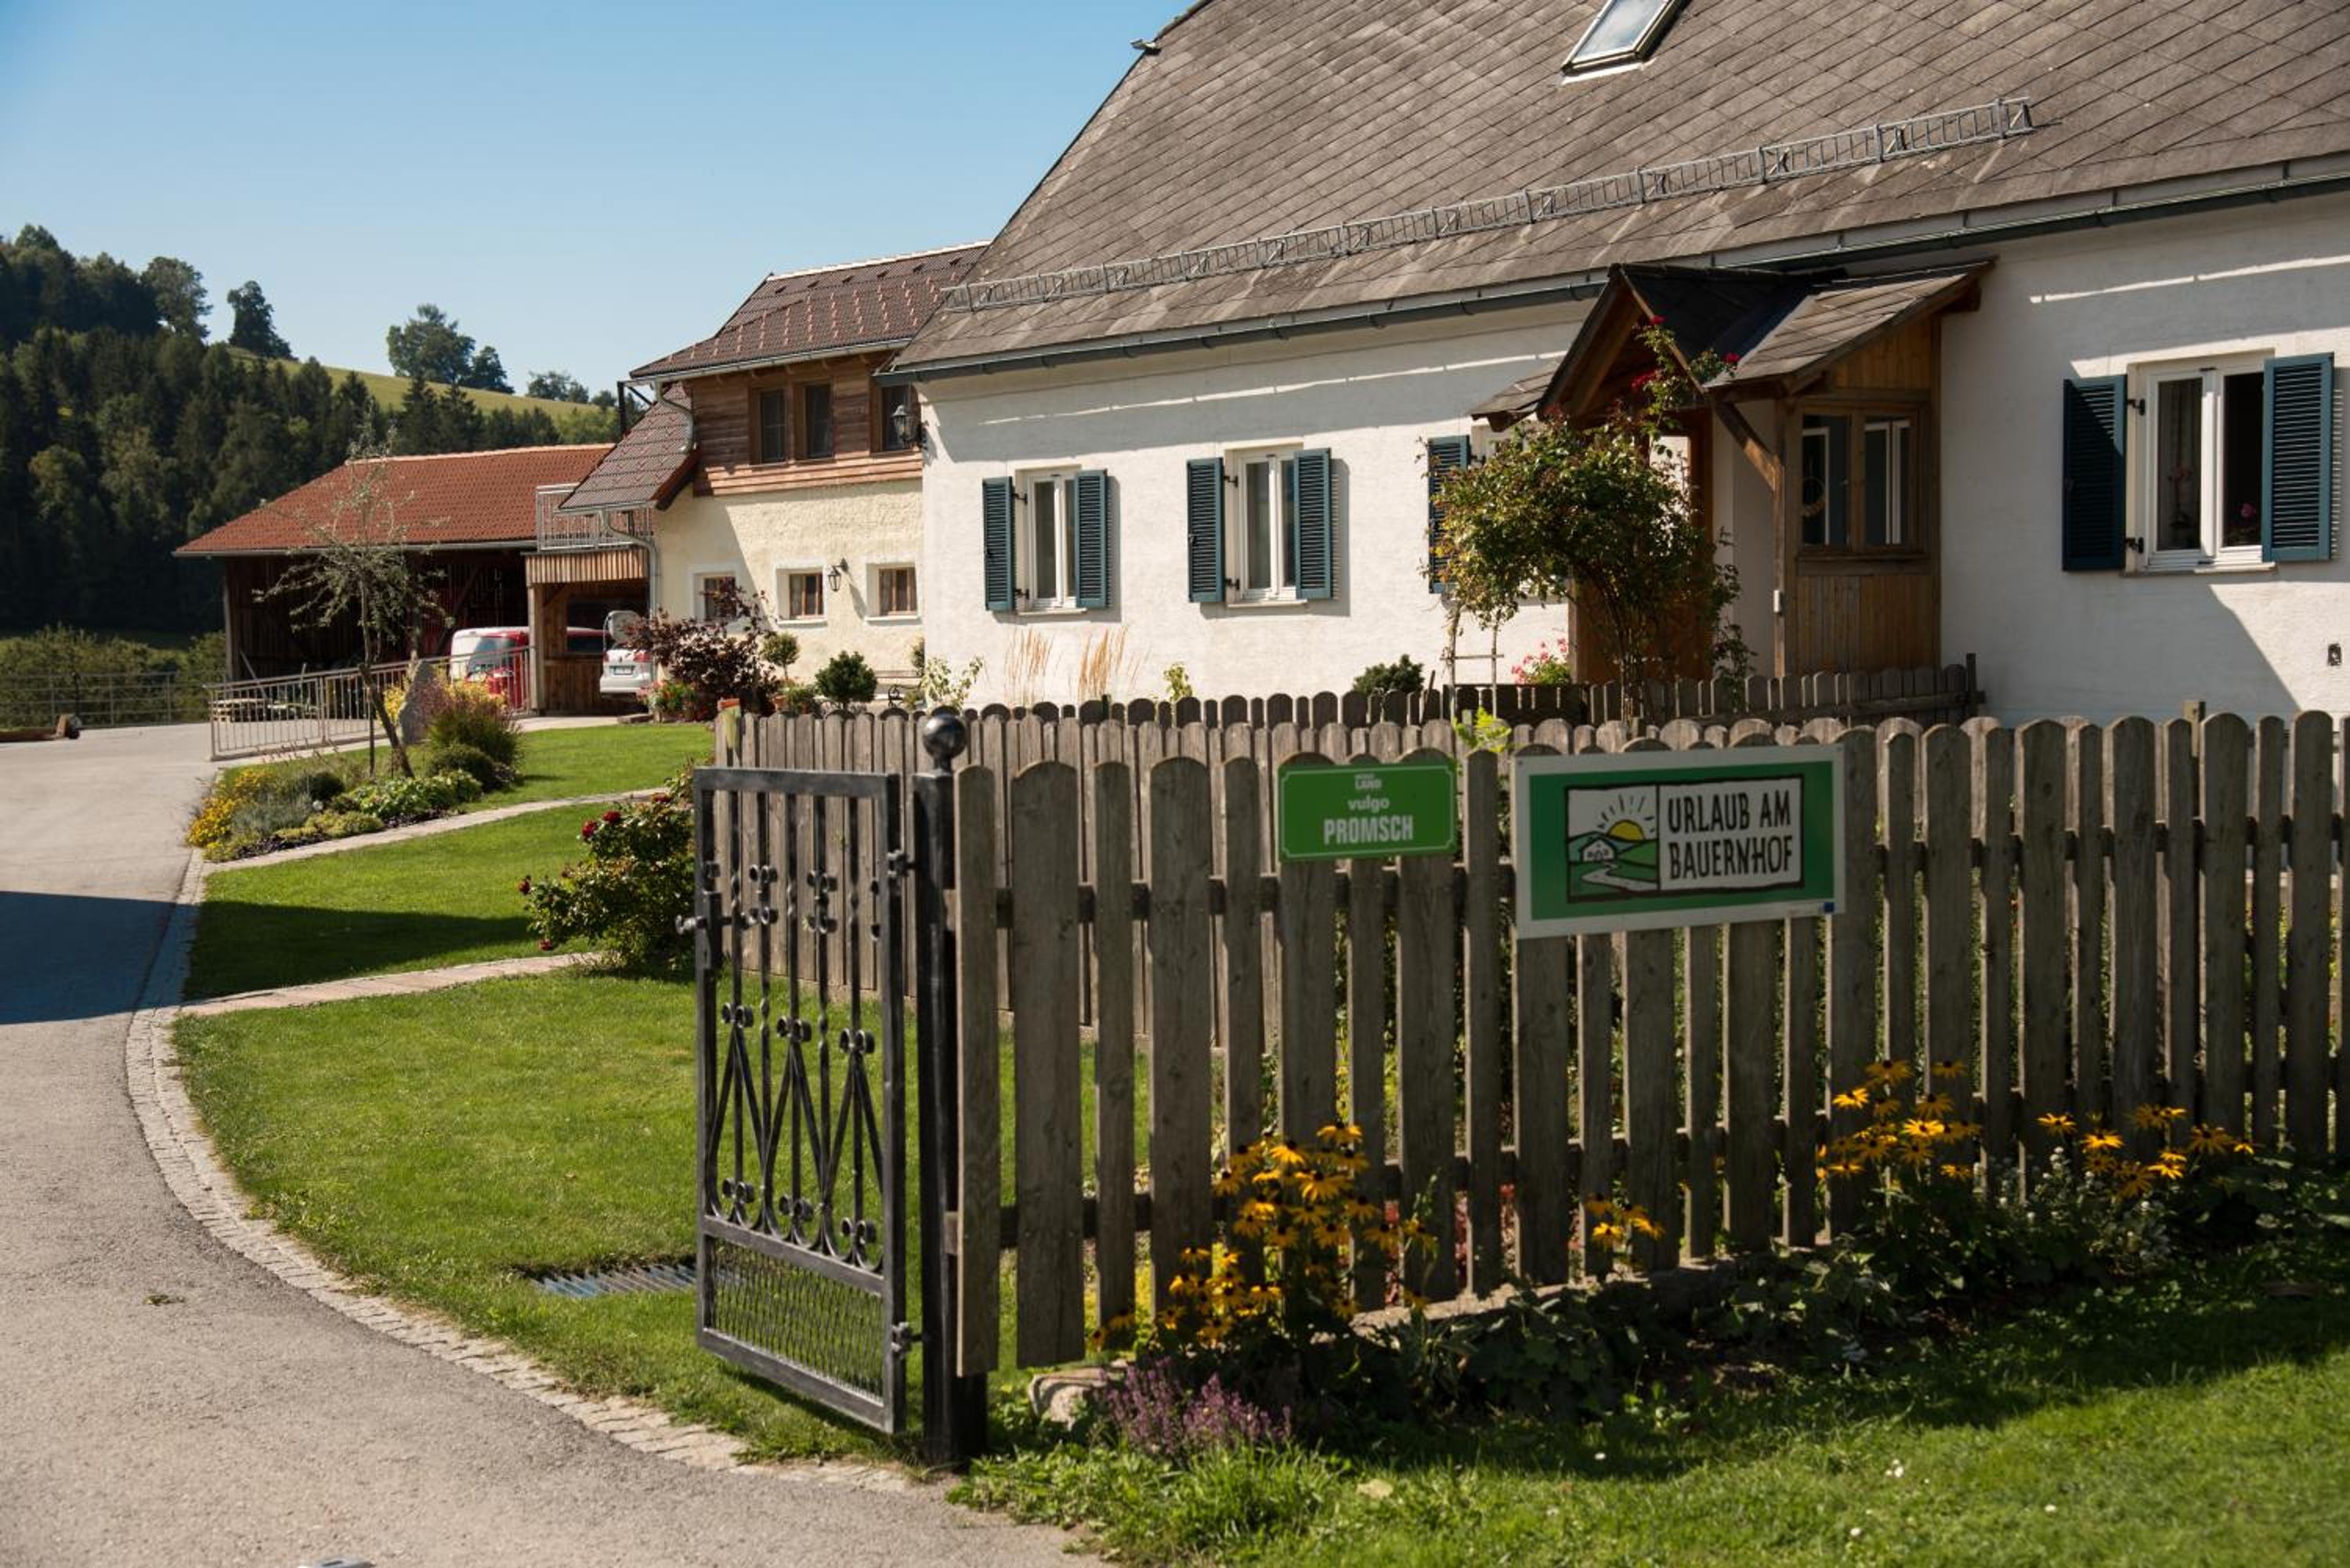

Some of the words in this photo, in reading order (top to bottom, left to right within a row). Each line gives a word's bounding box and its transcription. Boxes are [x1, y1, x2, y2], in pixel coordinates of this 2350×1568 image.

[1347, 794, 1390, 813] vulgo
[1668, 792, 1750, 834] URLAUB
[1759, 789, 1791, 828] AM
[1323, 815, 1414, 845] PROMSCH
[1668, 835, 1793, 880] BAUERNHOF
